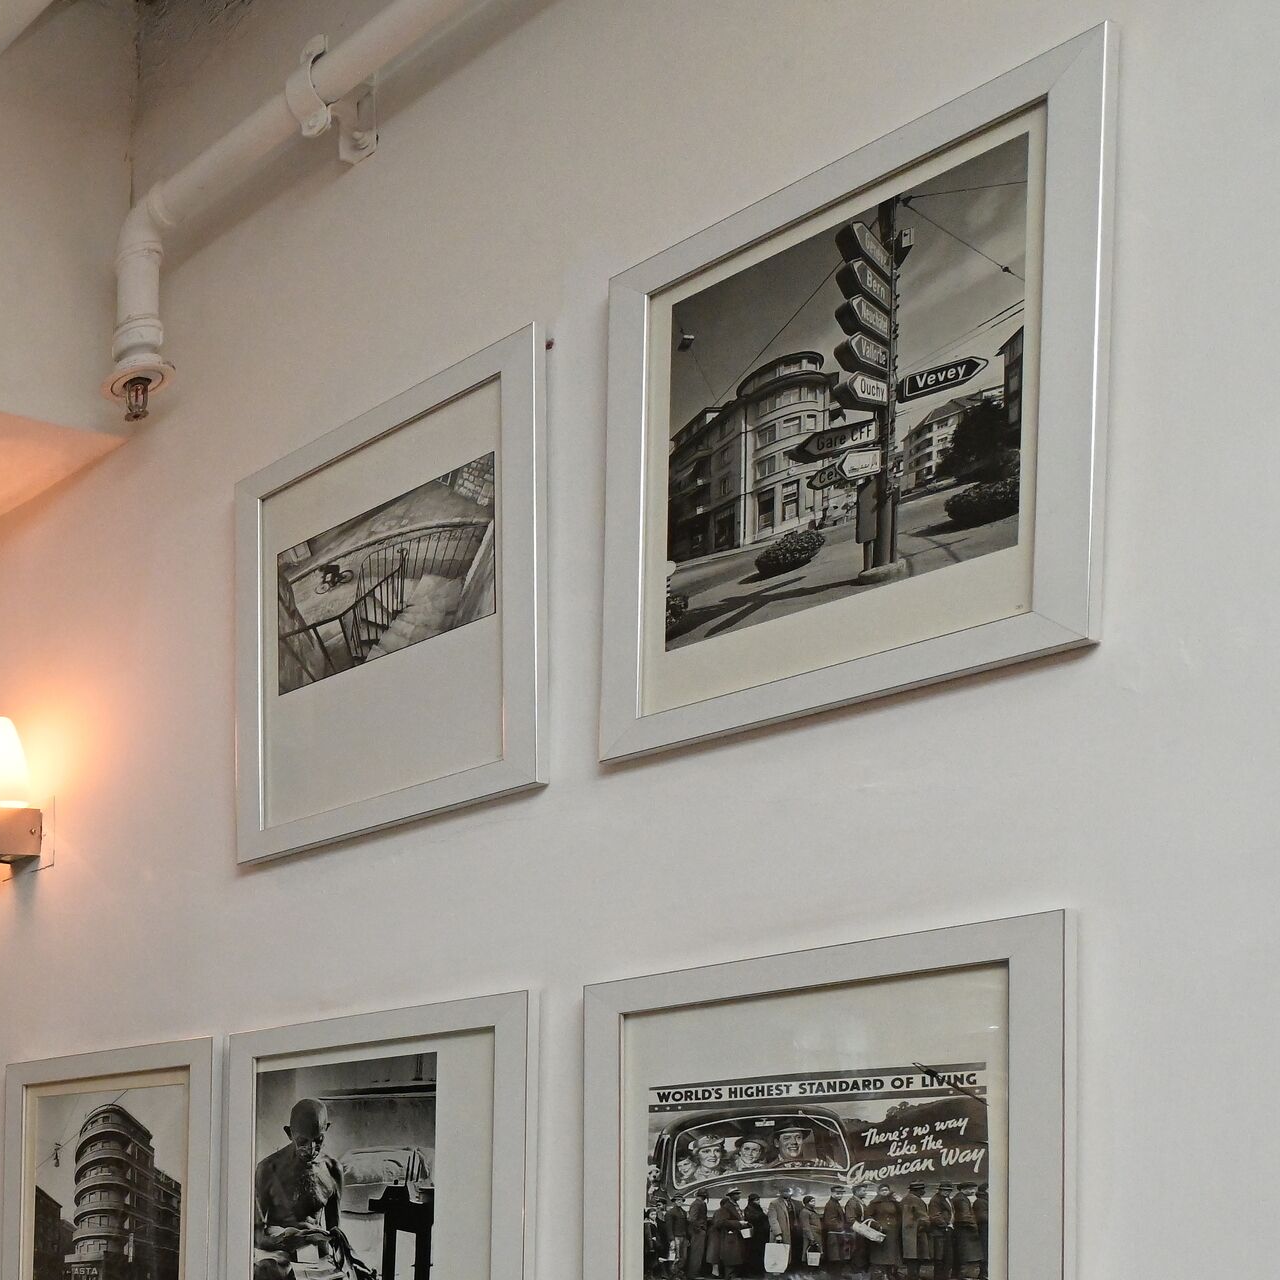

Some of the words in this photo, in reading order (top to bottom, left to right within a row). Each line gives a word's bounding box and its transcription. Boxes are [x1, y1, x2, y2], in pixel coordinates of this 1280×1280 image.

[866, 269, 886, 299] Bern
[861, 340, 886, 365] Vallorbe
[860, 379, 886, 398] Ouchy
[915, 364, 967, 388] Vevey
[816, 434, 847, 451] Gare
[850, 423, 873, 442] CFF
[656, 1087, 723, 1103] WORLD'S
[728, 1083, 792, 1100] HIGHEST
[798, 1079, 884, 1096] STANDARD
[892, 1077, 914, 1089] OF
[921, 1072, 977, 1087] LIVING
[861, 1122, 909, 1147] There's
[913, 1125, 931, 1136] no
[934, 1117, 969, 1136] way
[887, 1140, 915, 1157] like
[921, 1134, 944, 1151] the
[837, 1157, 936, 1186] American
[939, 1147, 987, 1174] Way
